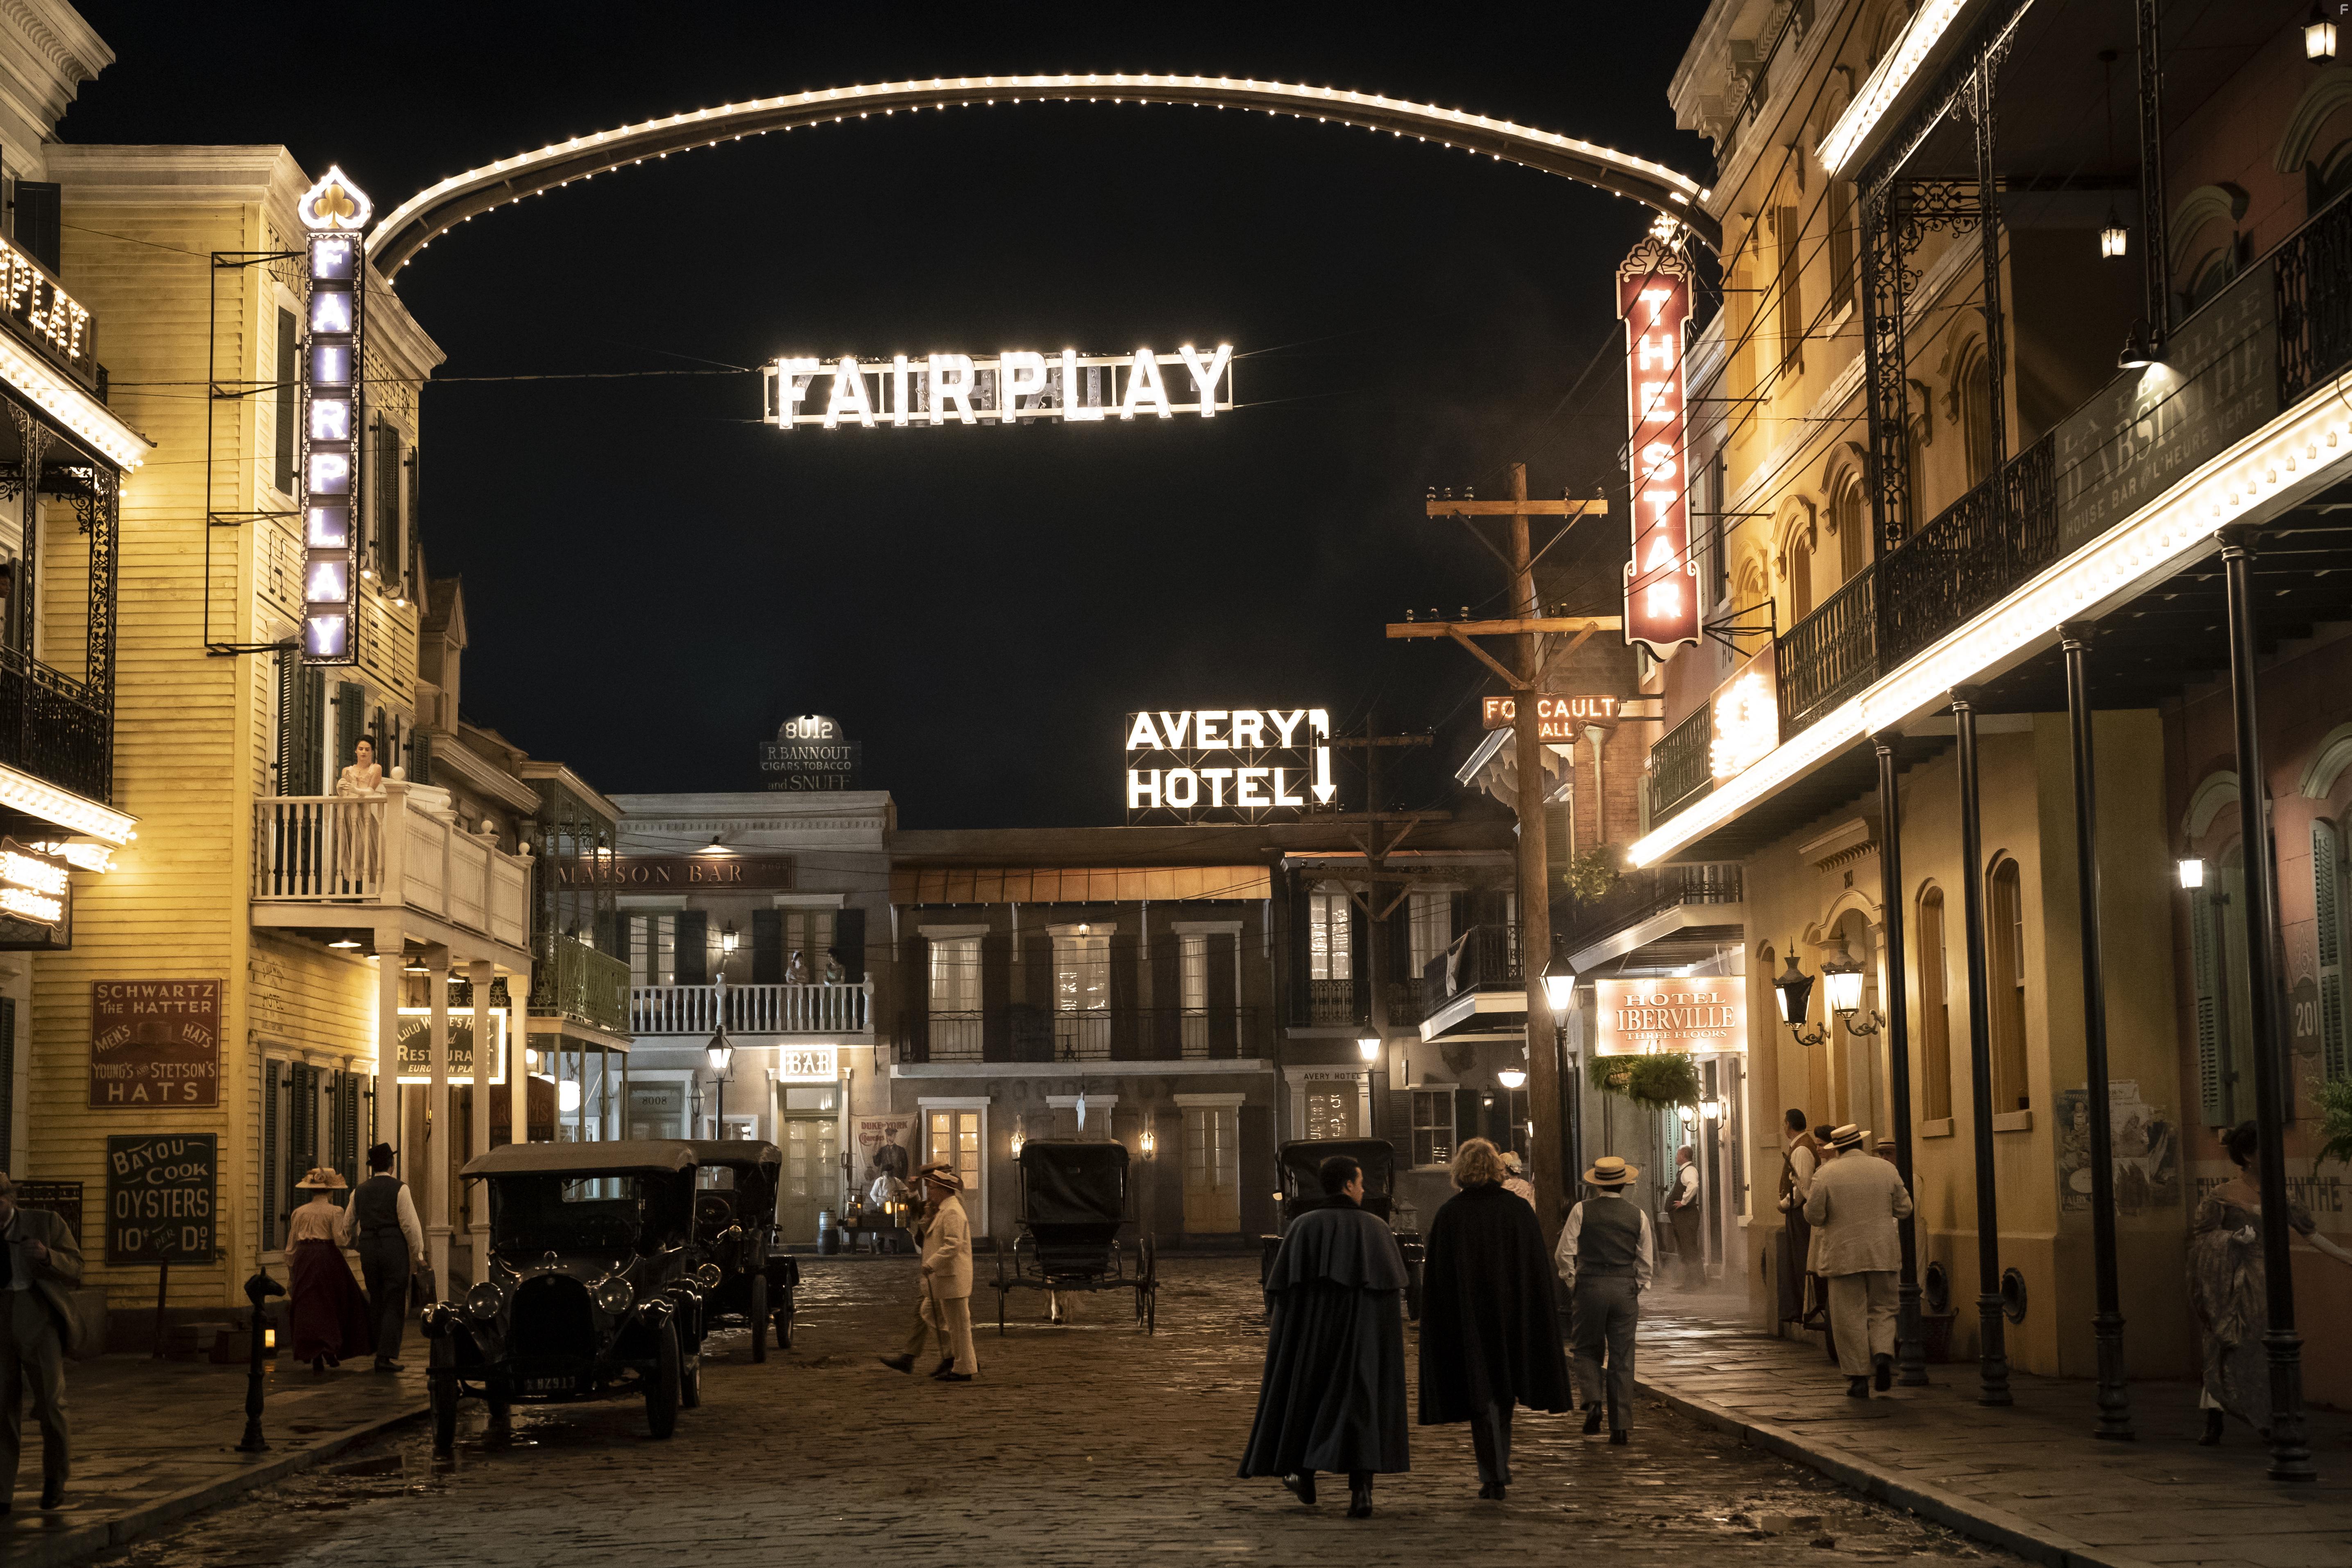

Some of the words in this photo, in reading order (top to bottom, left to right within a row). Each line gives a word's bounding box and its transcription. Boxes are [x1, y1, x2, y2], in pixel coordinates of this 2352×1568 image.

[1638, 289, 1674, 422] THE
[778, 344, 1234, 429] FAIRPLAY
[307, 240, 350, 654] FAIRPLAY
[2066, 498, 2105, 539] HOUSE
[2112, 477, 2137, 510] BAR
[1641, 442, 1682, 618] STAR
[1486, 698, 1615, 718] FOCAULT
[785, 715, 833, 739] 8012
[1126, 709, 1306, 750] AVERY
[1538, 723, 1574, 737] ALL
[803, 761, 851, 770] TOBACCO
[790, 775, 852, 791] SNUFF
[1128, 768, 1303, 808] HOTEL
[689, 865, 743, 883] BAR
[97, 984, 213, 998] SCHWARTZ
[1624, 992, 1727, 1007] HOTEL
[133, 1001, 211, 1014] HATTER
[397, 1022, 421, 1042] LULU
[420, 1017, 463, 1030] WE'S
[1616, 1006, 1736, 1032] IBERVILLE
[95, 1024, 131, 1053] MEN'S
[182, 1023, 213, 1048] HATS
[1625, 1031, 1671, 1040] THREE
[1674, 1029, 1727, 1039] FLOORS
[397, 1045, 494, 1062] RESTURA
[786, 1051, 832, 1074] BAR
[92, 1062, 134, 1079] YOUNG'S
[150, 1061, 215, 1079] STETSON'S
[408, 1065, 455, 1073] EURON
[108, 1082, 198, 1101] HATS
[642, 1096, 667, 1105] 8008
[861, 1122, 881, 1130] DUKE
[886, 1121, 908, 1129] YORK
[113, 1139, 184, 1175] BAYOU
[146, 1163, 208, 1185] COOK
[116, 1188, 209, 1219] OYSTERS
